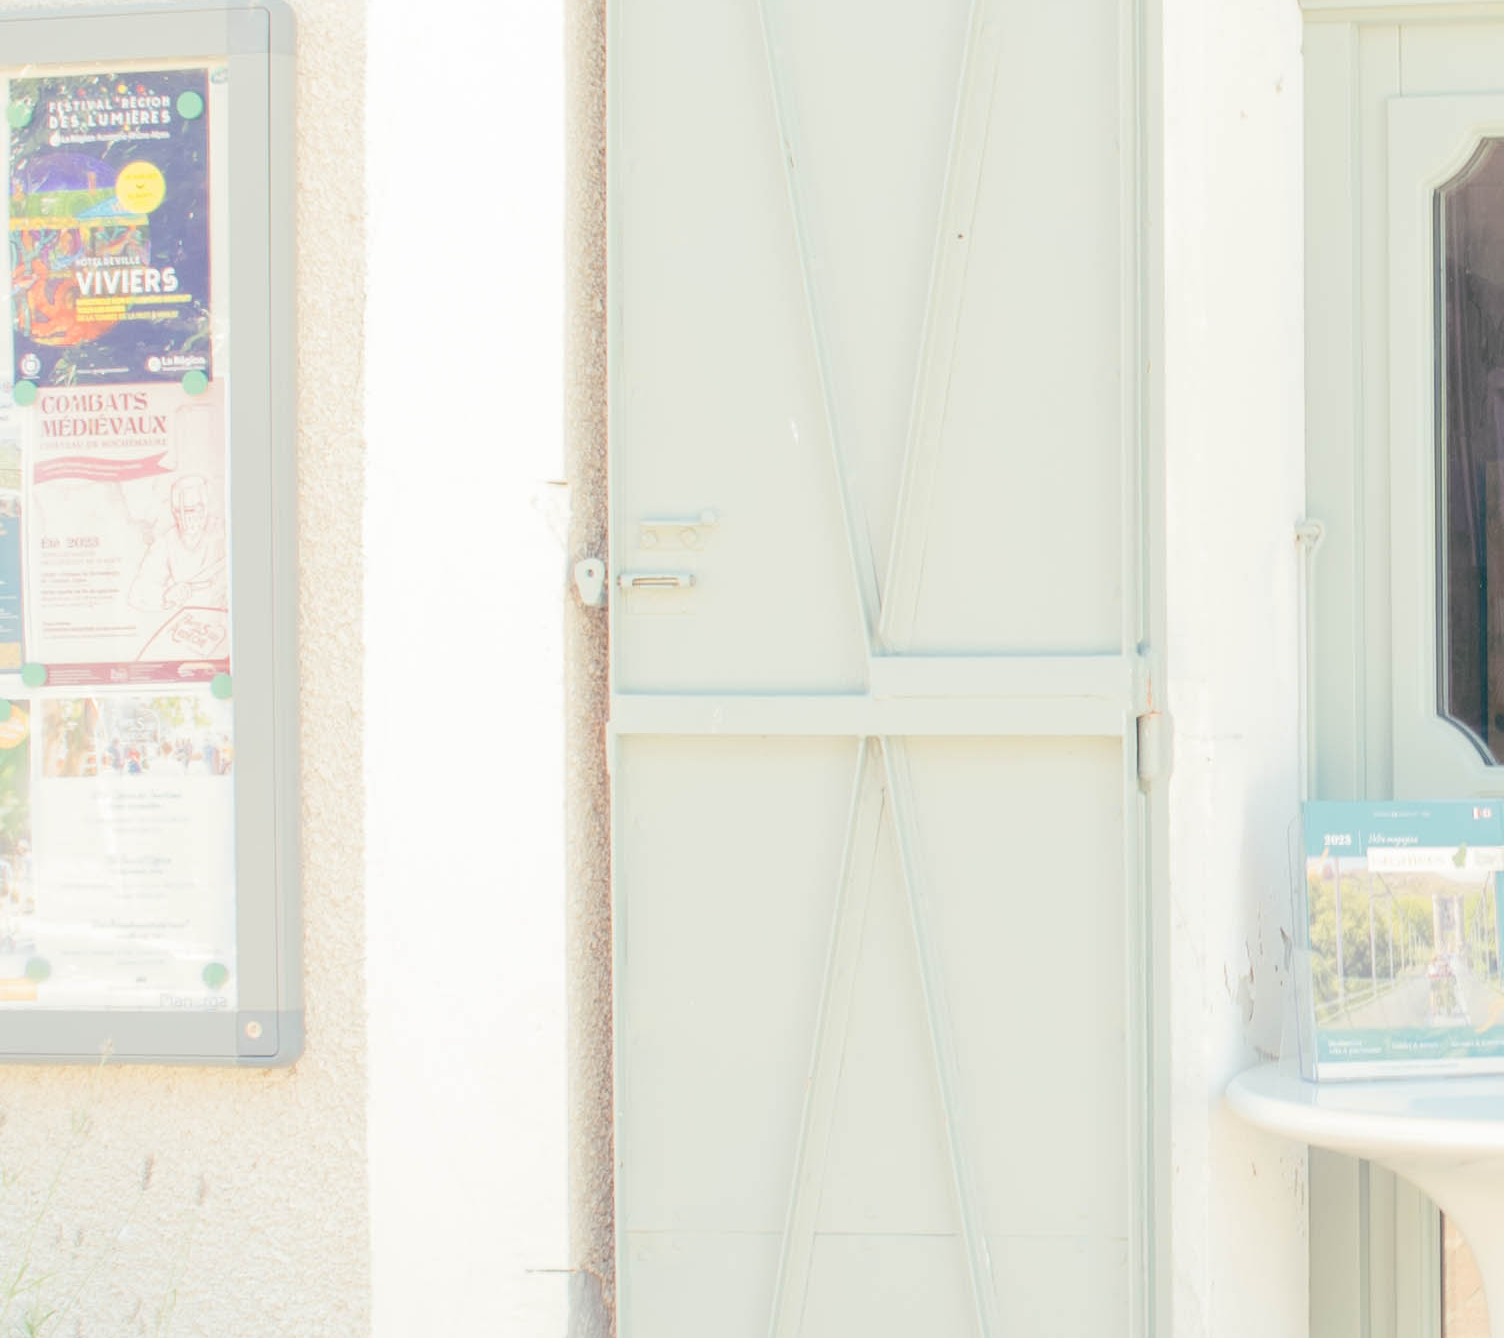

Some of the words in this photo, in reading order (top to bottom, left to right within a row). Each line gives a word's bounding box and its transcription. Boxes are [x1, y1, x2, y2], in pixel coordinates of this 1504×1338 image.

[49, 114, 80, 129] DES
[75, 267, 179, 295] VIVIERS
[41, 392, 149, 414] COMBATS
[40, 414, 168, 437] MÉDIÉVAUX
